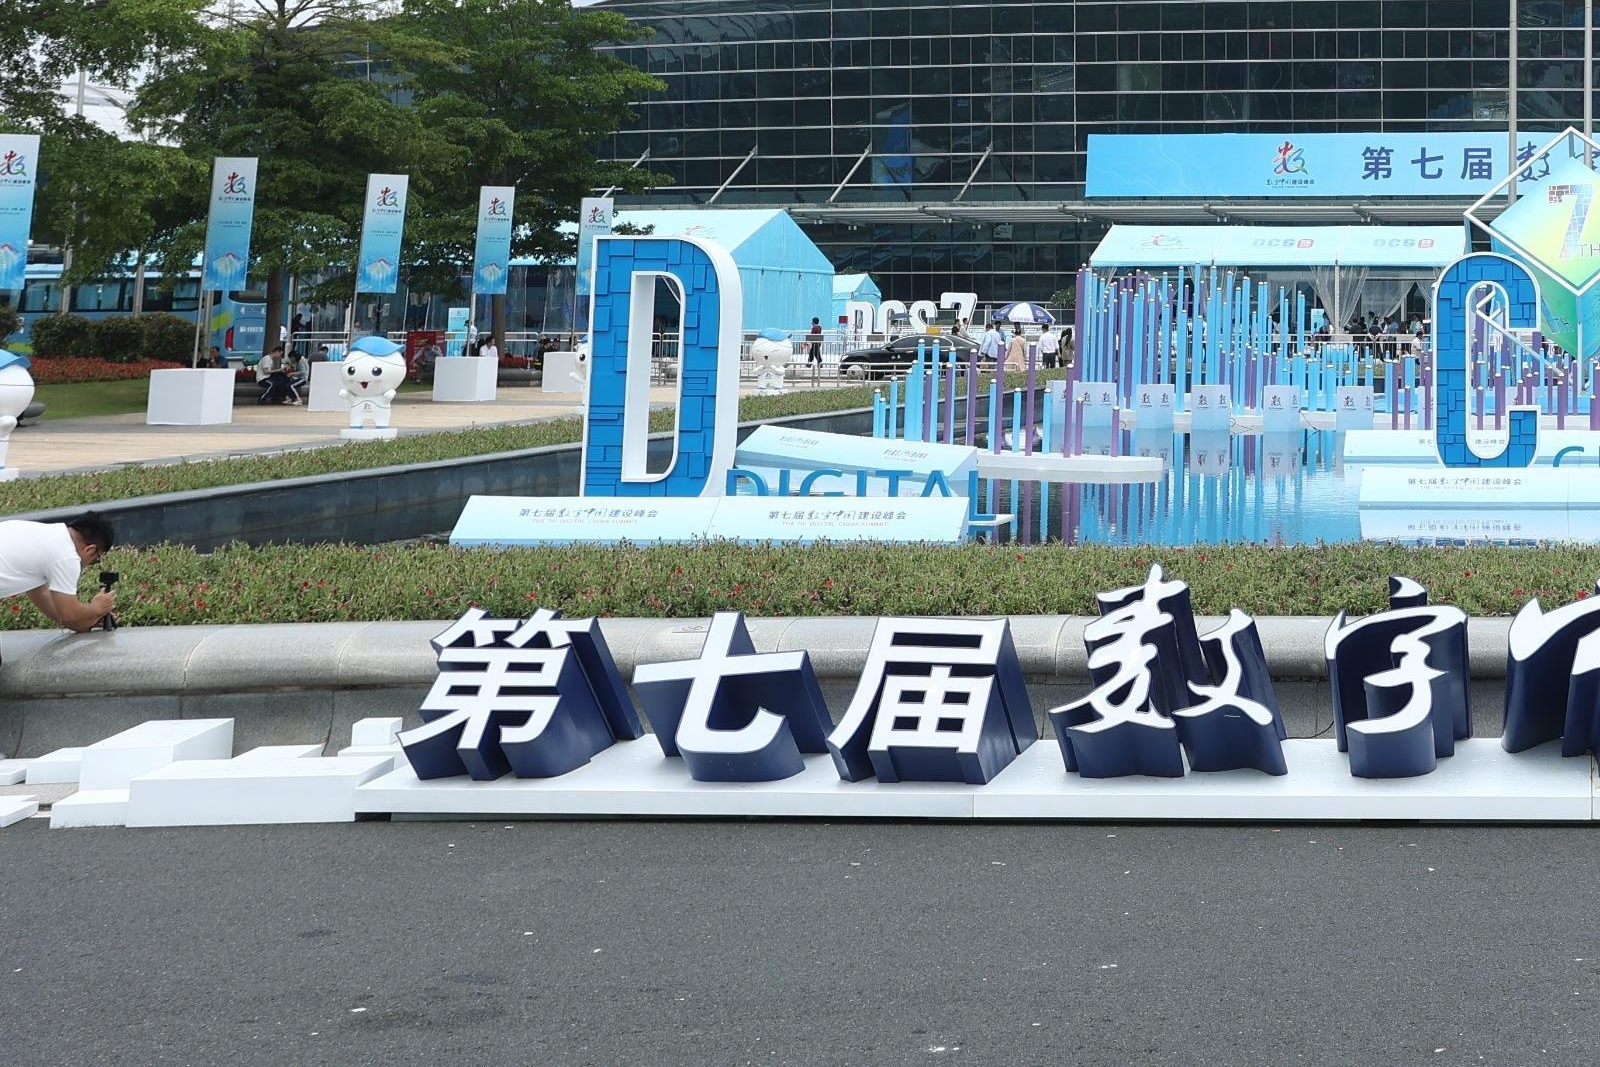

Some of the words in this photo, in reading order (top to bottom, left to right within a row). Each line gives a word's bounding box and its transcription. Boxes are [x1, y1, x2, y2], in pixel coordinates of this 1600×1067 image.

[768, 510, 907, 520] 第七届数字中国建设峰会
